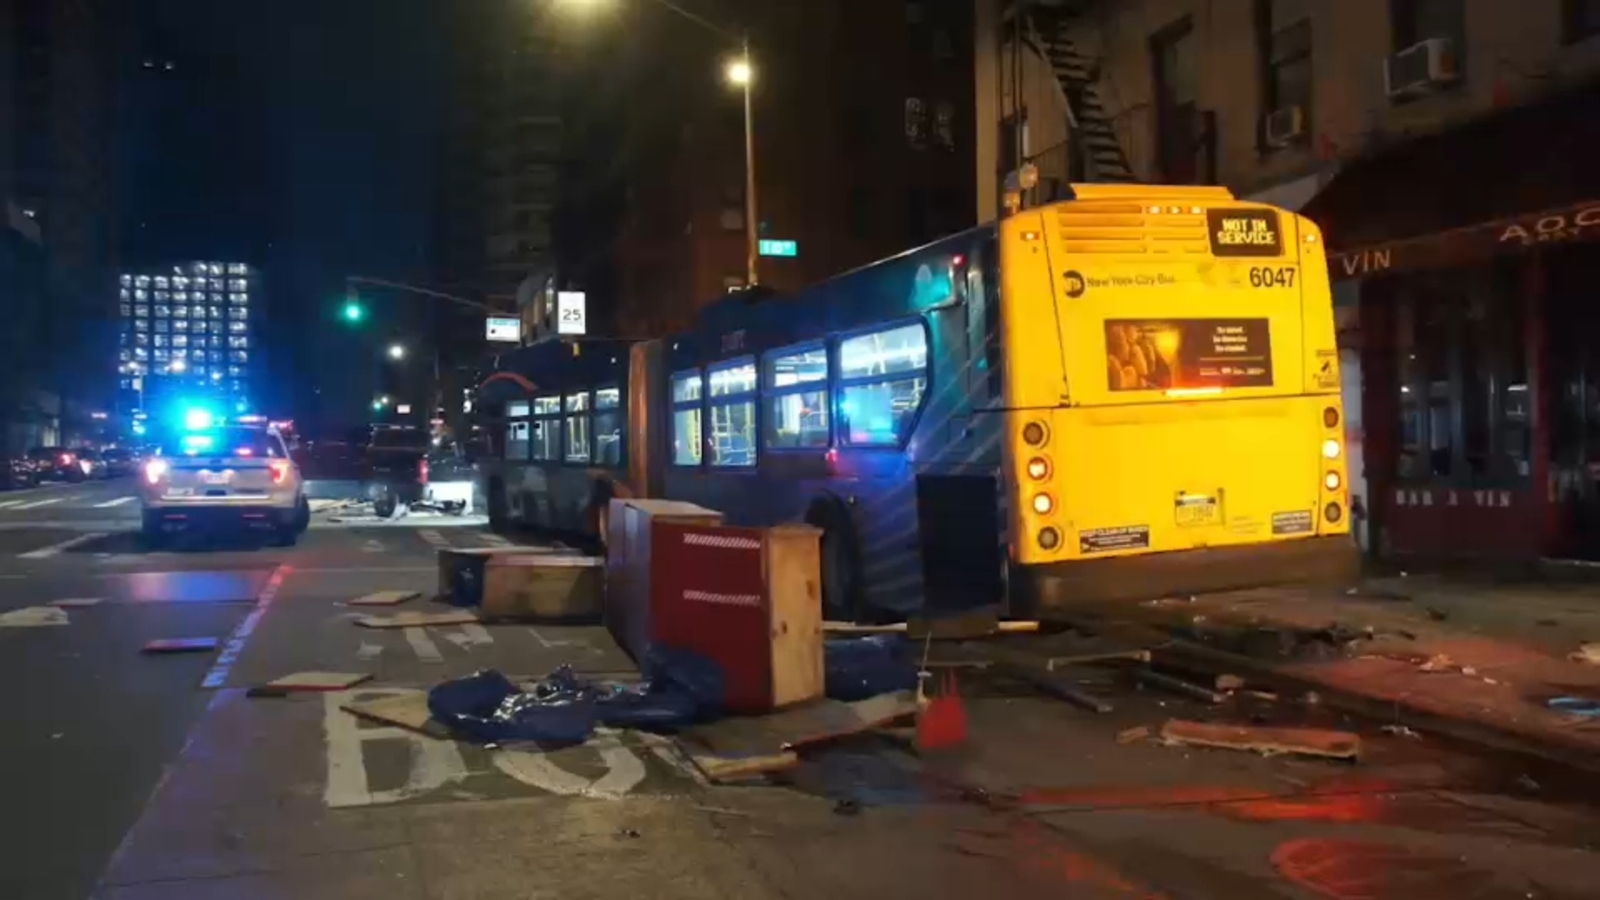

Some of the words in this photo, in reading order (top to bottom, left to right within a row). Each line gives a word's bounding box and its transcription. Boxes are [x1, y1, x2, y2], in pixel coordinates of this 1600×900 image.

[1222, 219, 1248, 231] NOT
[1251, 219, 1266, 231] IN
[1217, 231, 1276, 245] SERVICE
[1342, 250, 1391, 275] VIN
[1086, 277, 1109, 288] New
[1111, 276, 1134, 287] York
[1135, 274, 1155, 287] City
[1249, 267, 1296, 287] 6047
[562, 309, 581, 321] 25
